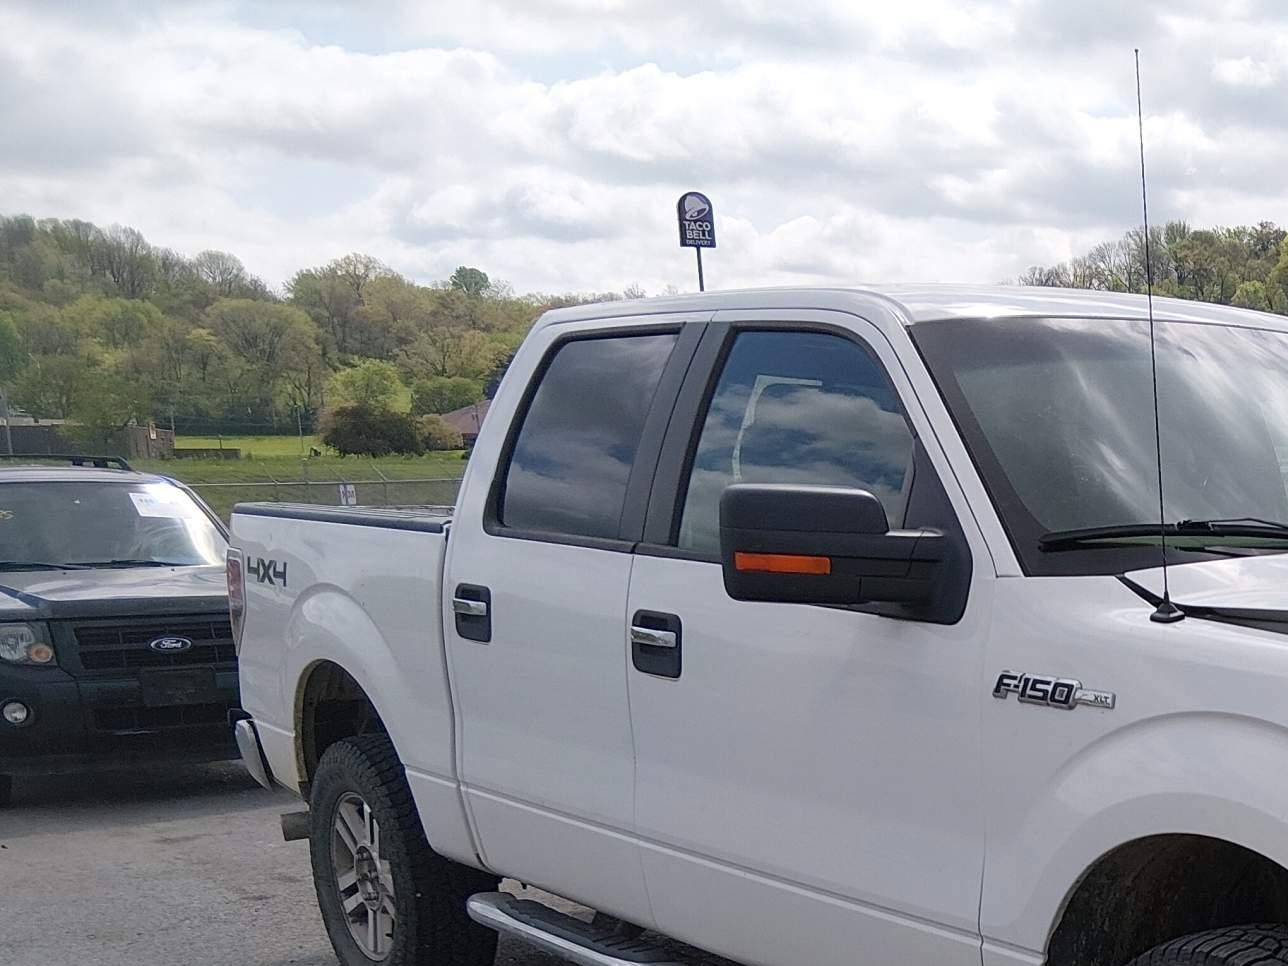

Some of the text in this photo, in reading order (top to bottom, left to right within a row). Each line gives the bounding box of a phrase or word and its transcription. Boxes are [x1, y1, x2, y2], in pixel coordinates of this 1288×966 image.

[683, 221, 711, 231] TACO
[686, 230, 713, 240] BELL
[1093, 693, 1111, 705] XLT
